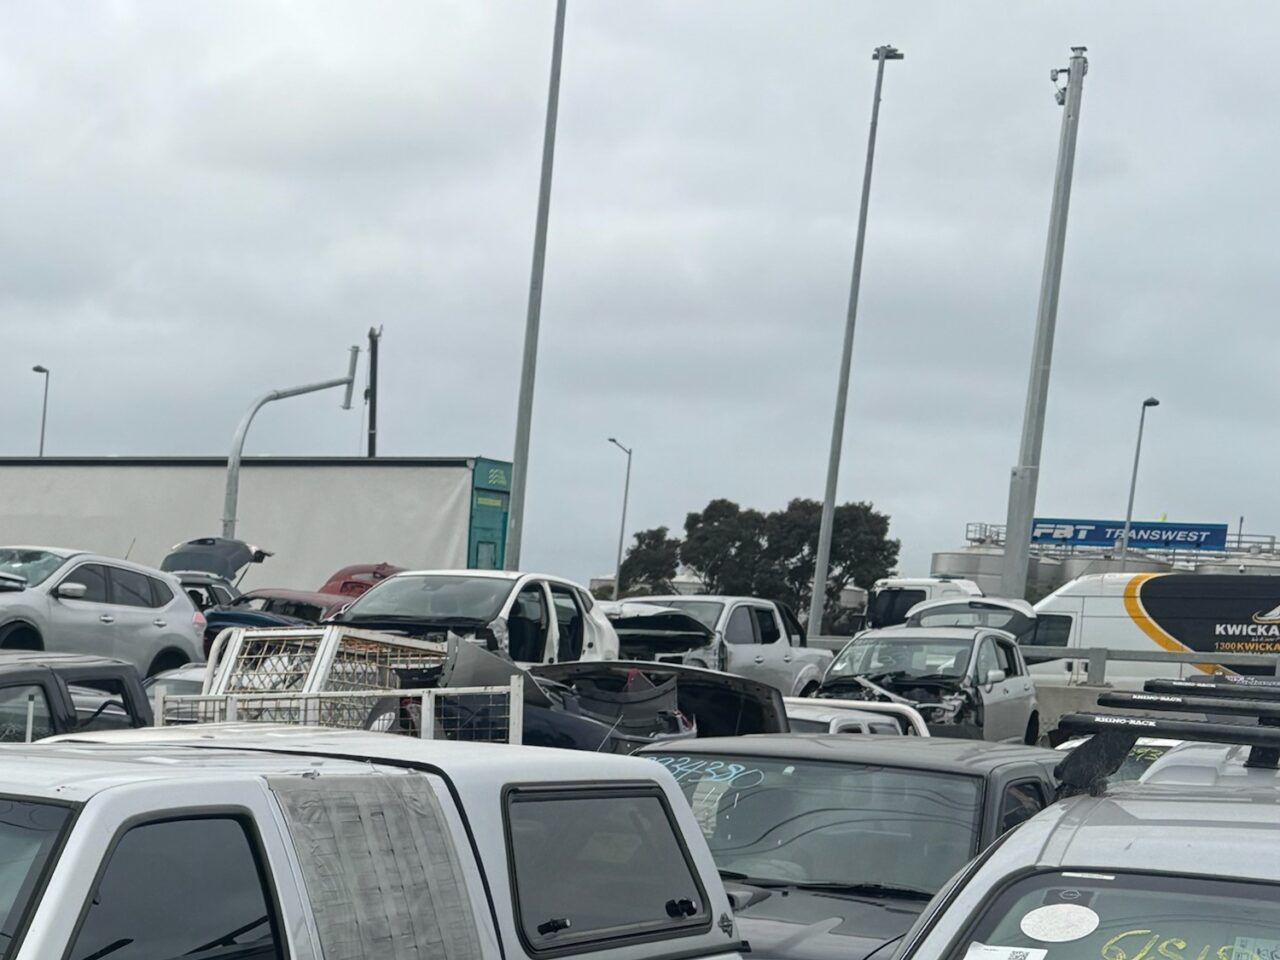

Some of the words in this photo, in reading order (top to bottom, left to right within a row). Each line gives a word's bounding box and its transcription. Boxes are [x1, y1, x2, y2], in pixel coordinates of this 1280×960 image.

[1032, 523, 1096, 540] FBT
[1105, 528, 1211, 542] TRANSWEST
[1094, 716, 1157, 727] RHINO-RACK
